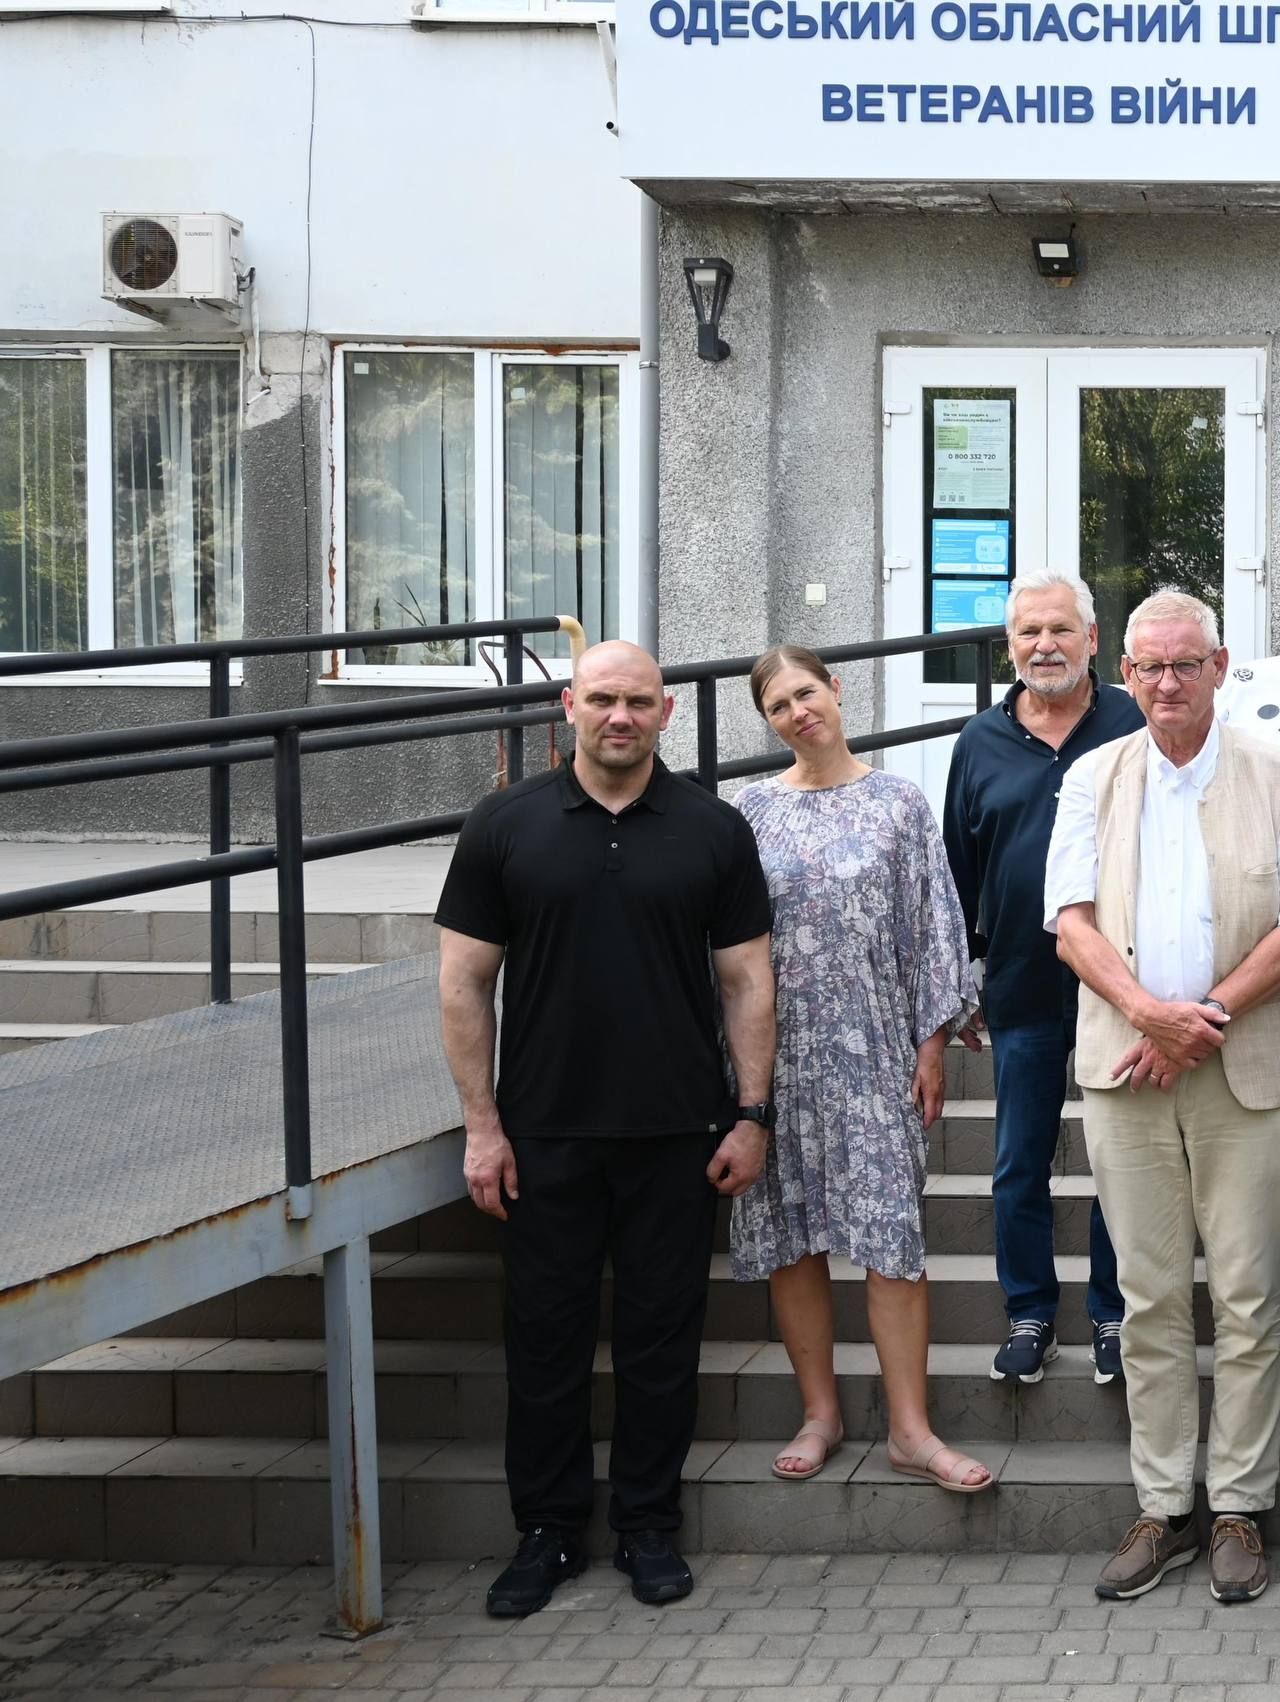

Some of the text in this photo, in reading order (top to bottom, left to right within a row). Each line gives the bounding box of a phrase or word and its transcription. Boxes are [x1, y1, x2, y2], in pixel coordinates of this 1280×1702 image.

[649, 0, 915, 45] ОДЕСЬКИЙ
[931, 0, 1201, 42] ОБЛАСНИЙ
[822, 78, 1256, 125] ВЕТЕРАНІВ ВІЙНИ
